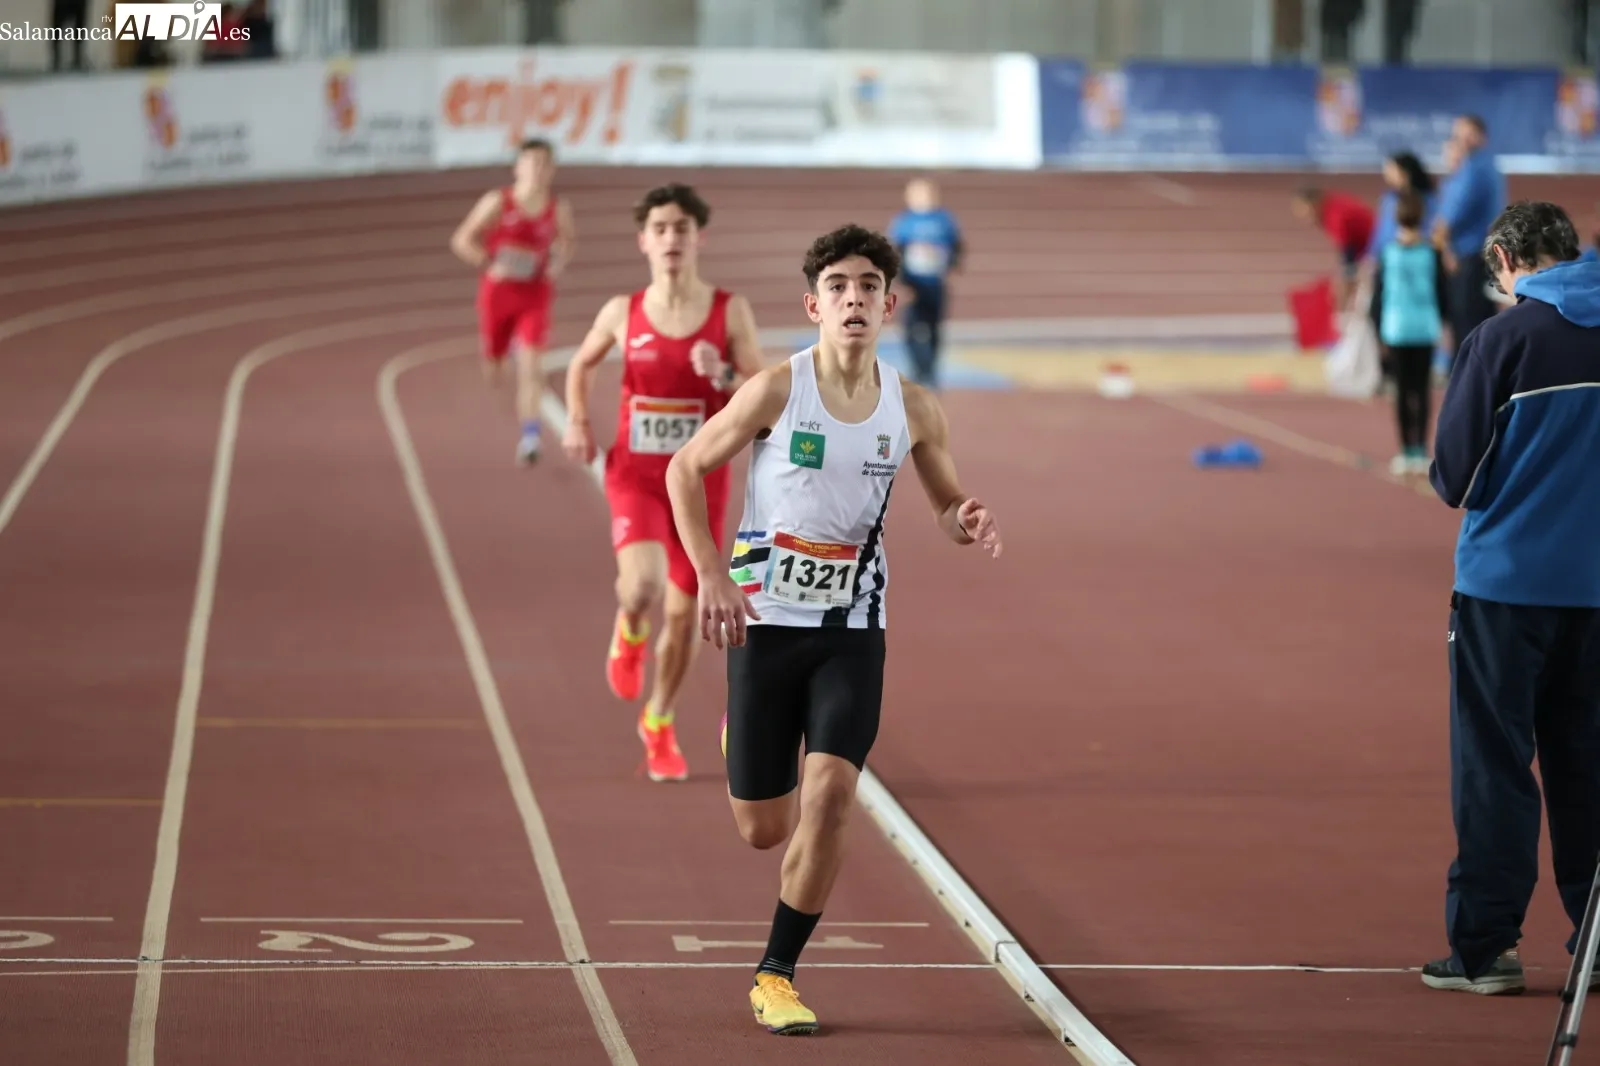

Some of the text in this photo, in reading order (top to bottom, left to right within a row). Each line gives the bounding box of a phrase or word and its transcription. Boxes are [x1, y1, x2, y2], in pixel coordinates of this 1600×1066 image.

[443, 60, 630, 146] enjoy!
[642, 418, 697, 439] 1057
[862, 468, 870, 476] de
[779, 555, 852, 590] 1321
[258, 930, 475, 953] 2
